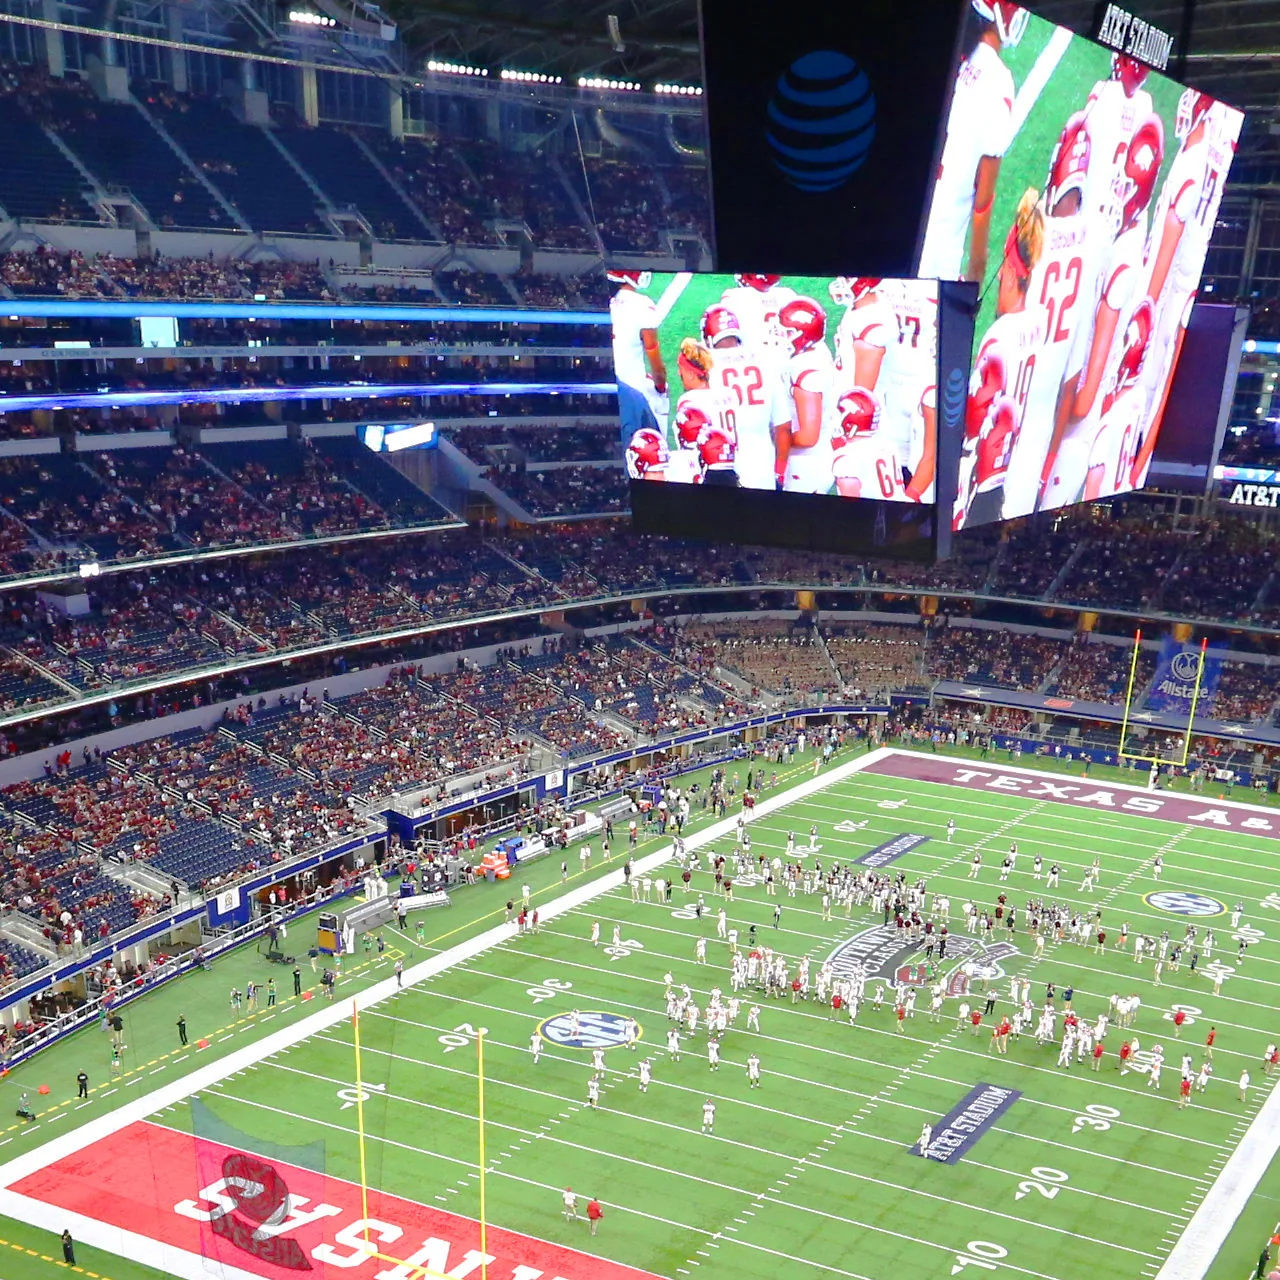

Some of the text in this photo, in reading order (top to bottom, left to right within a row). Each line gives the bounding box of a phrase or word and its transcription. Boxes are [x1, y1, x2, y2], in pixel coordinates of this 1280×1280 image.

[1098, 3, 1174, 70] AT&T STADIUM
[951, 768, 1166, 814] TEXAS
[526, 978, 573, 999] 30
[437, 1023, 489, 1047] 20
[336, 1081, 386, 1102] 10
[924, 1085, 1013, 1161] AT&T STADIUM
[1074, 1104, 1121, 1131] 30
[1018, 1166, 1069, 1200] 20
[955, 1240, 1008, 1270] 10
